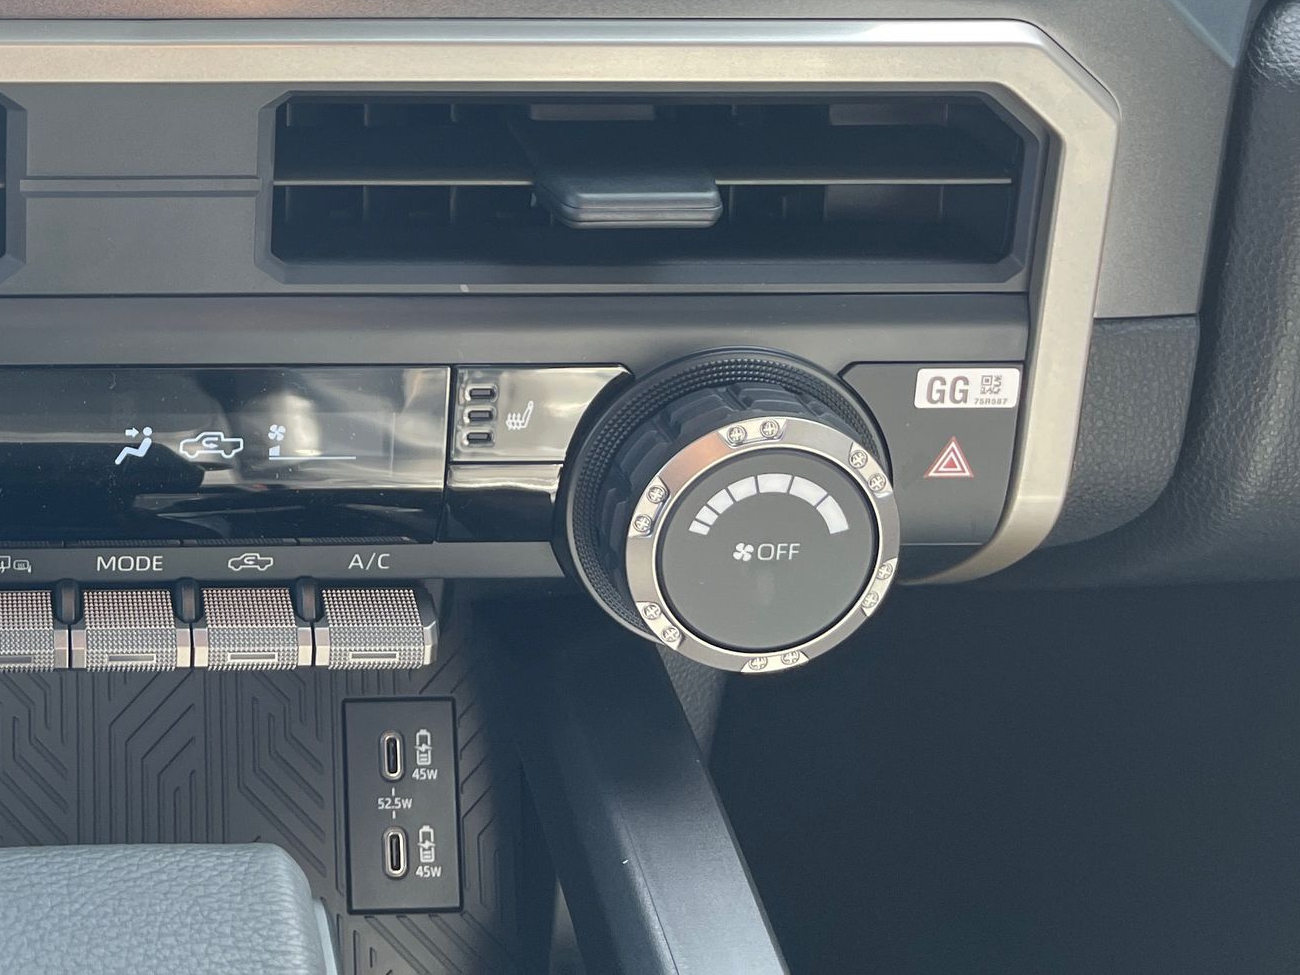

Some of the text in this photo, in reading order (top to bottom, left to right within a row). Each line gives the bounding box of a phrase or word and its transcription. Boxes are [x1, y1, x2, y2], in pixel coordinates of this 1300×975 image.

[926, 376, 969, 405] GG
[757, 543, 800, 560] OFF
[97, 555, 164, 572] MODE
[348, 554, 390, 571] A/C
[412, 768, 438, 780] 45W
[377, 798, 413, 810] 52.5W
[415, 866, 442, 877] 45W
